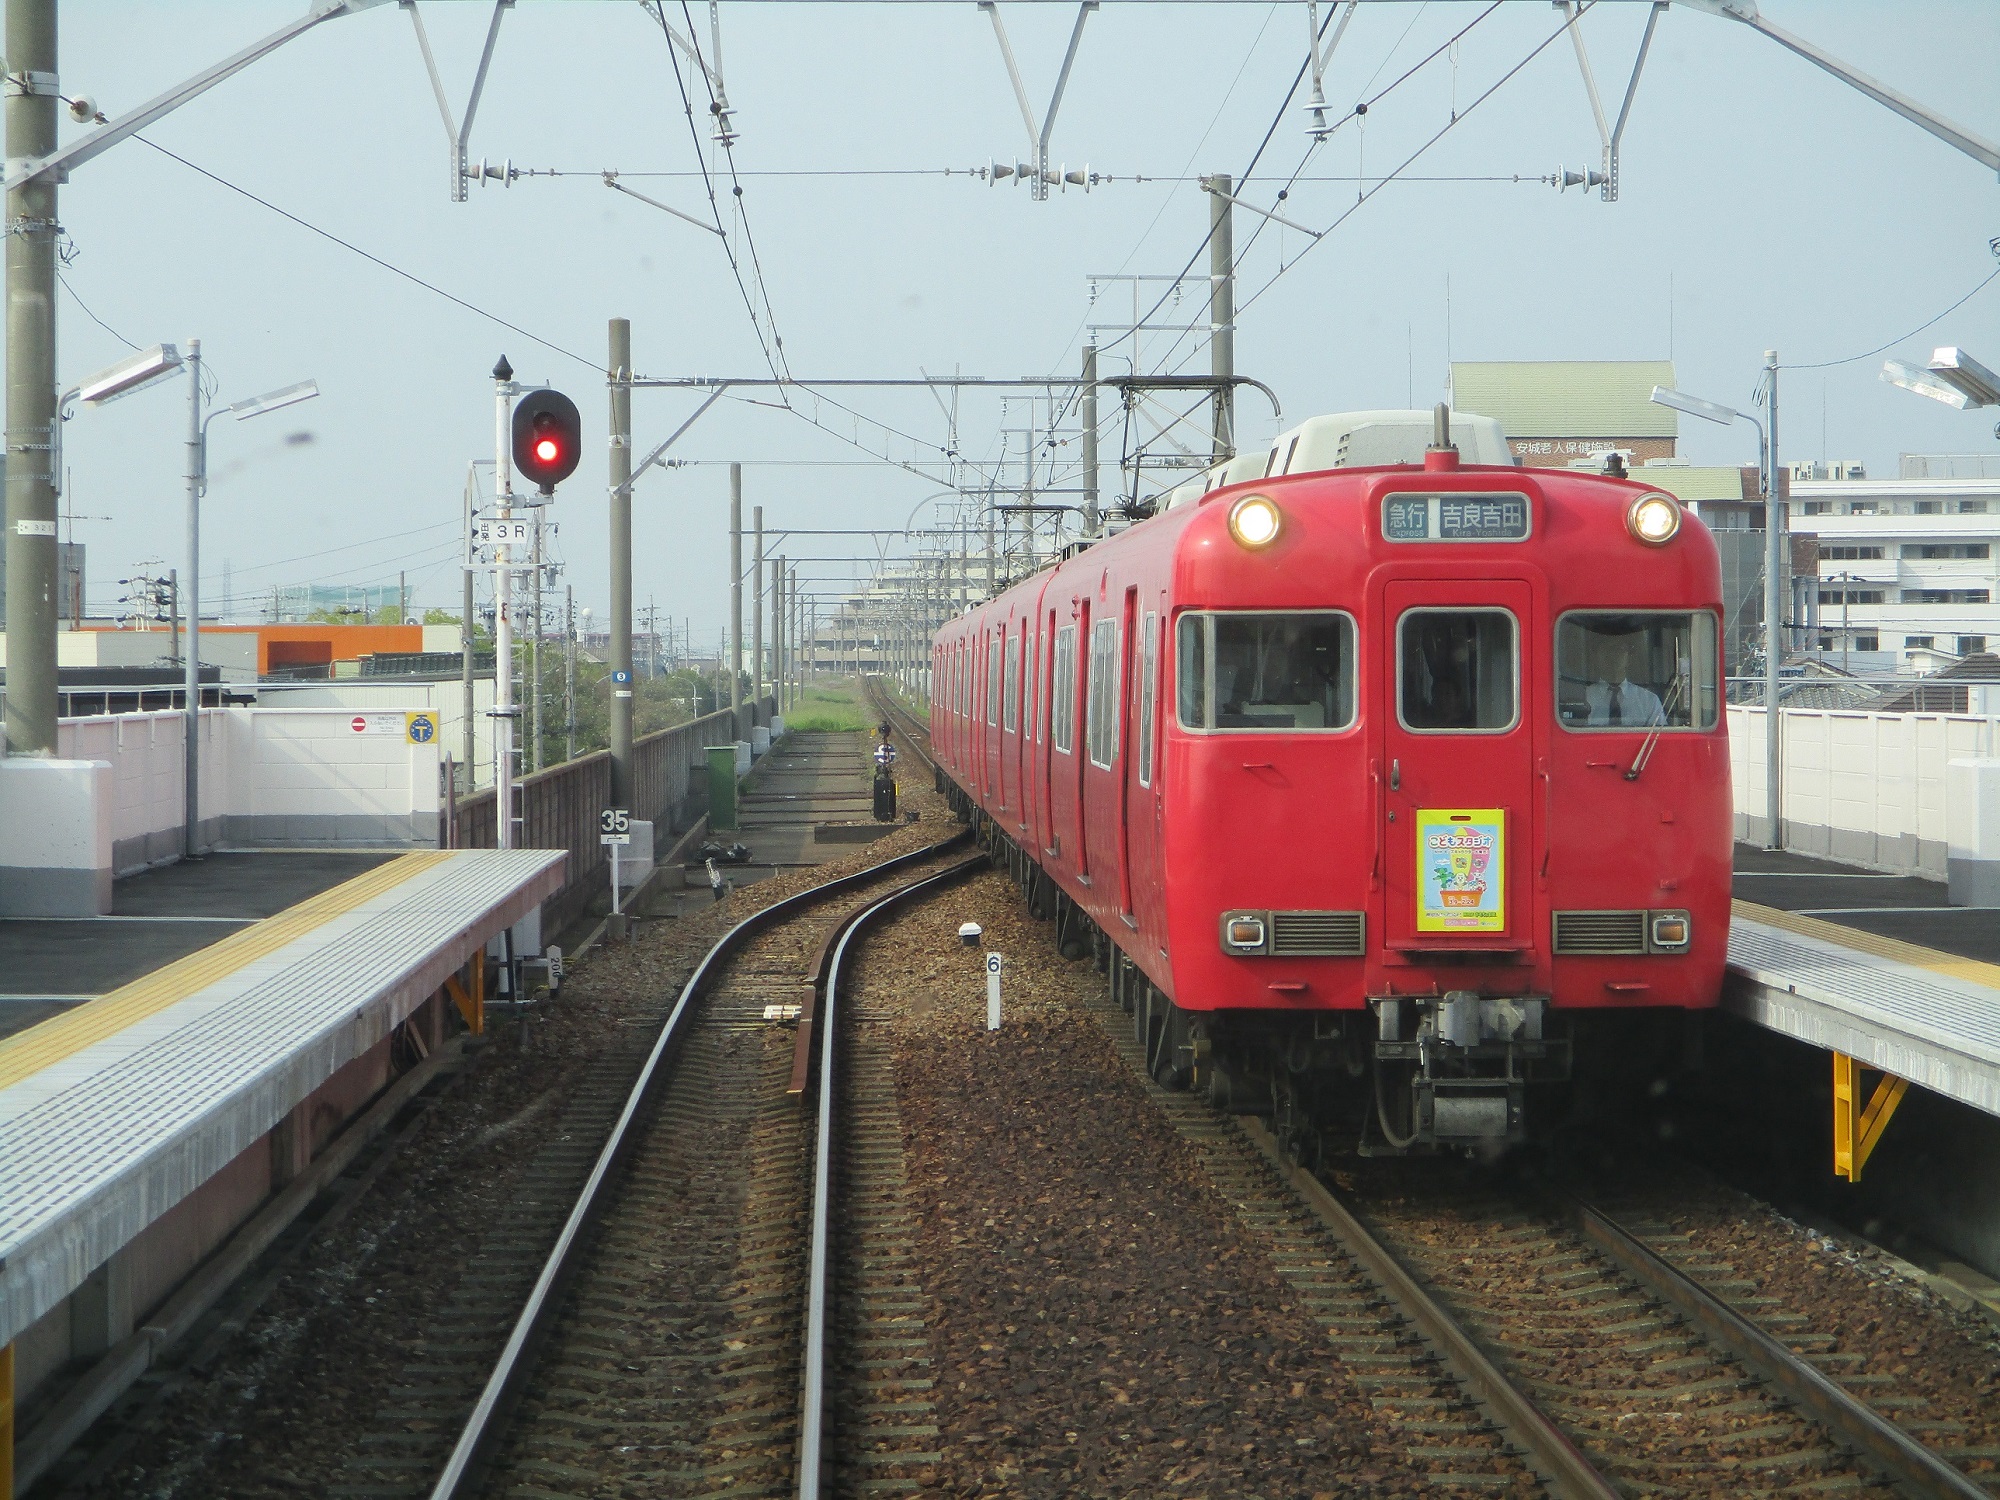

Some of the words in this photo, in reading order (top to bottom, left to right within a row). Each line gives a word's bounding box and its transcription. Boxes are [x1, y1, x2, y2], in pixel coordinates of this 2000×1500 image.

[1389, 502, 1425, 528] 急行
[1442, 502, 1522, 528] 吉良吉田
[480, 522, 490, 542] 出発
[1390, 528, 1424, 537] Express
[601, 809, 629, 832] 35
[1429, 834, 1493, 848] こどもスタジオ
[987, 955, 1000, 973] 6
